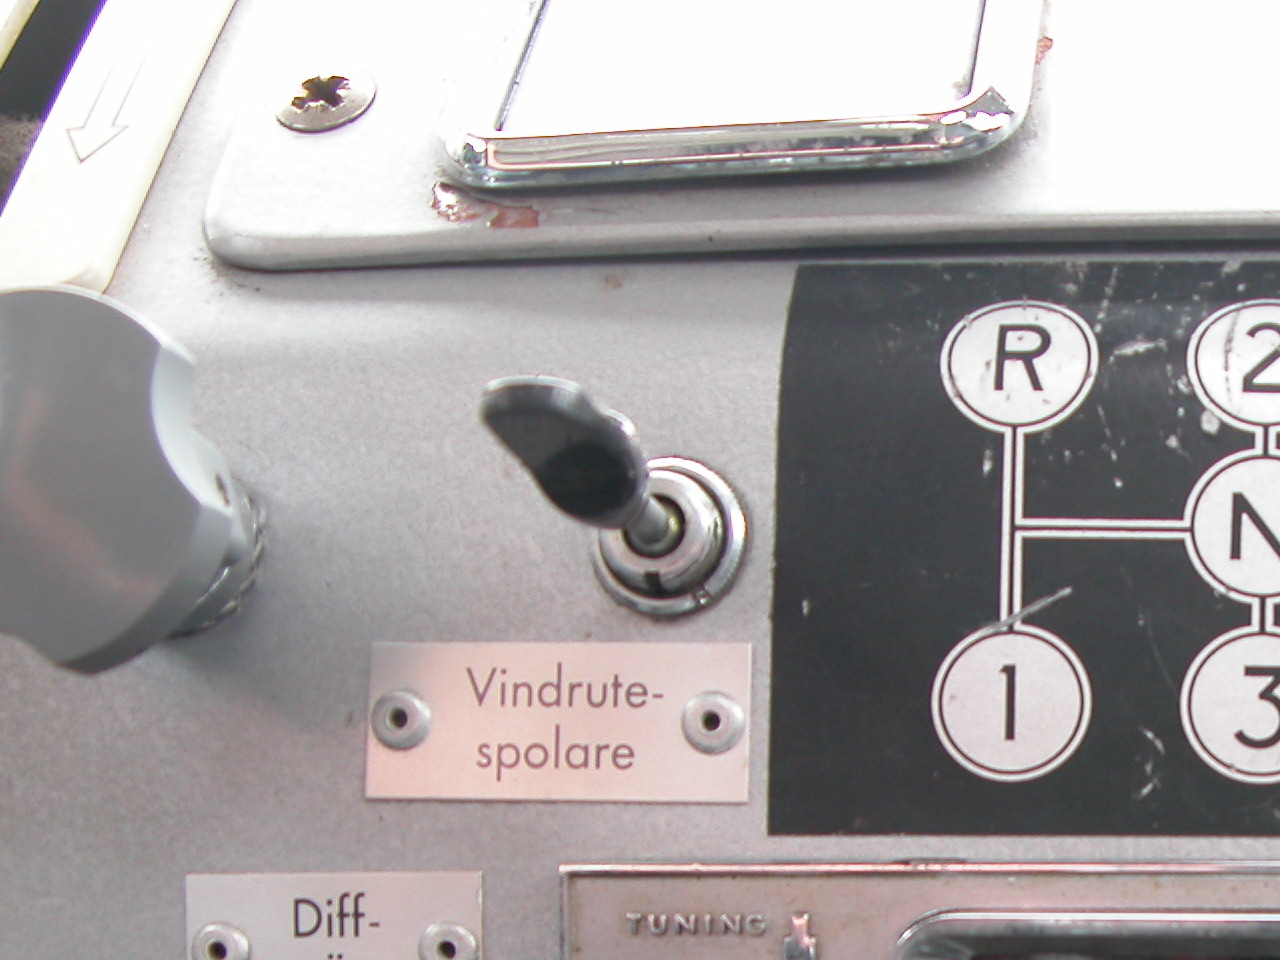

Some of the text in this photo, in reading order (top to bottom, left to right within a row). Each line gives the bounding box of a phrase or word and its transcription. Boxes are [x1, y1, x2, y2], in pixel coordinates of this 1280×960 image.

[993, 323, 1052, 392] R
[466, 661, 664, 707] Vindrute-
[999, 664, 1017, 741] 1
[476, 723, 635, 782] spolare
[293, 892, 380, 938] Diff-
[625, 911, 768, 936] TUNING
